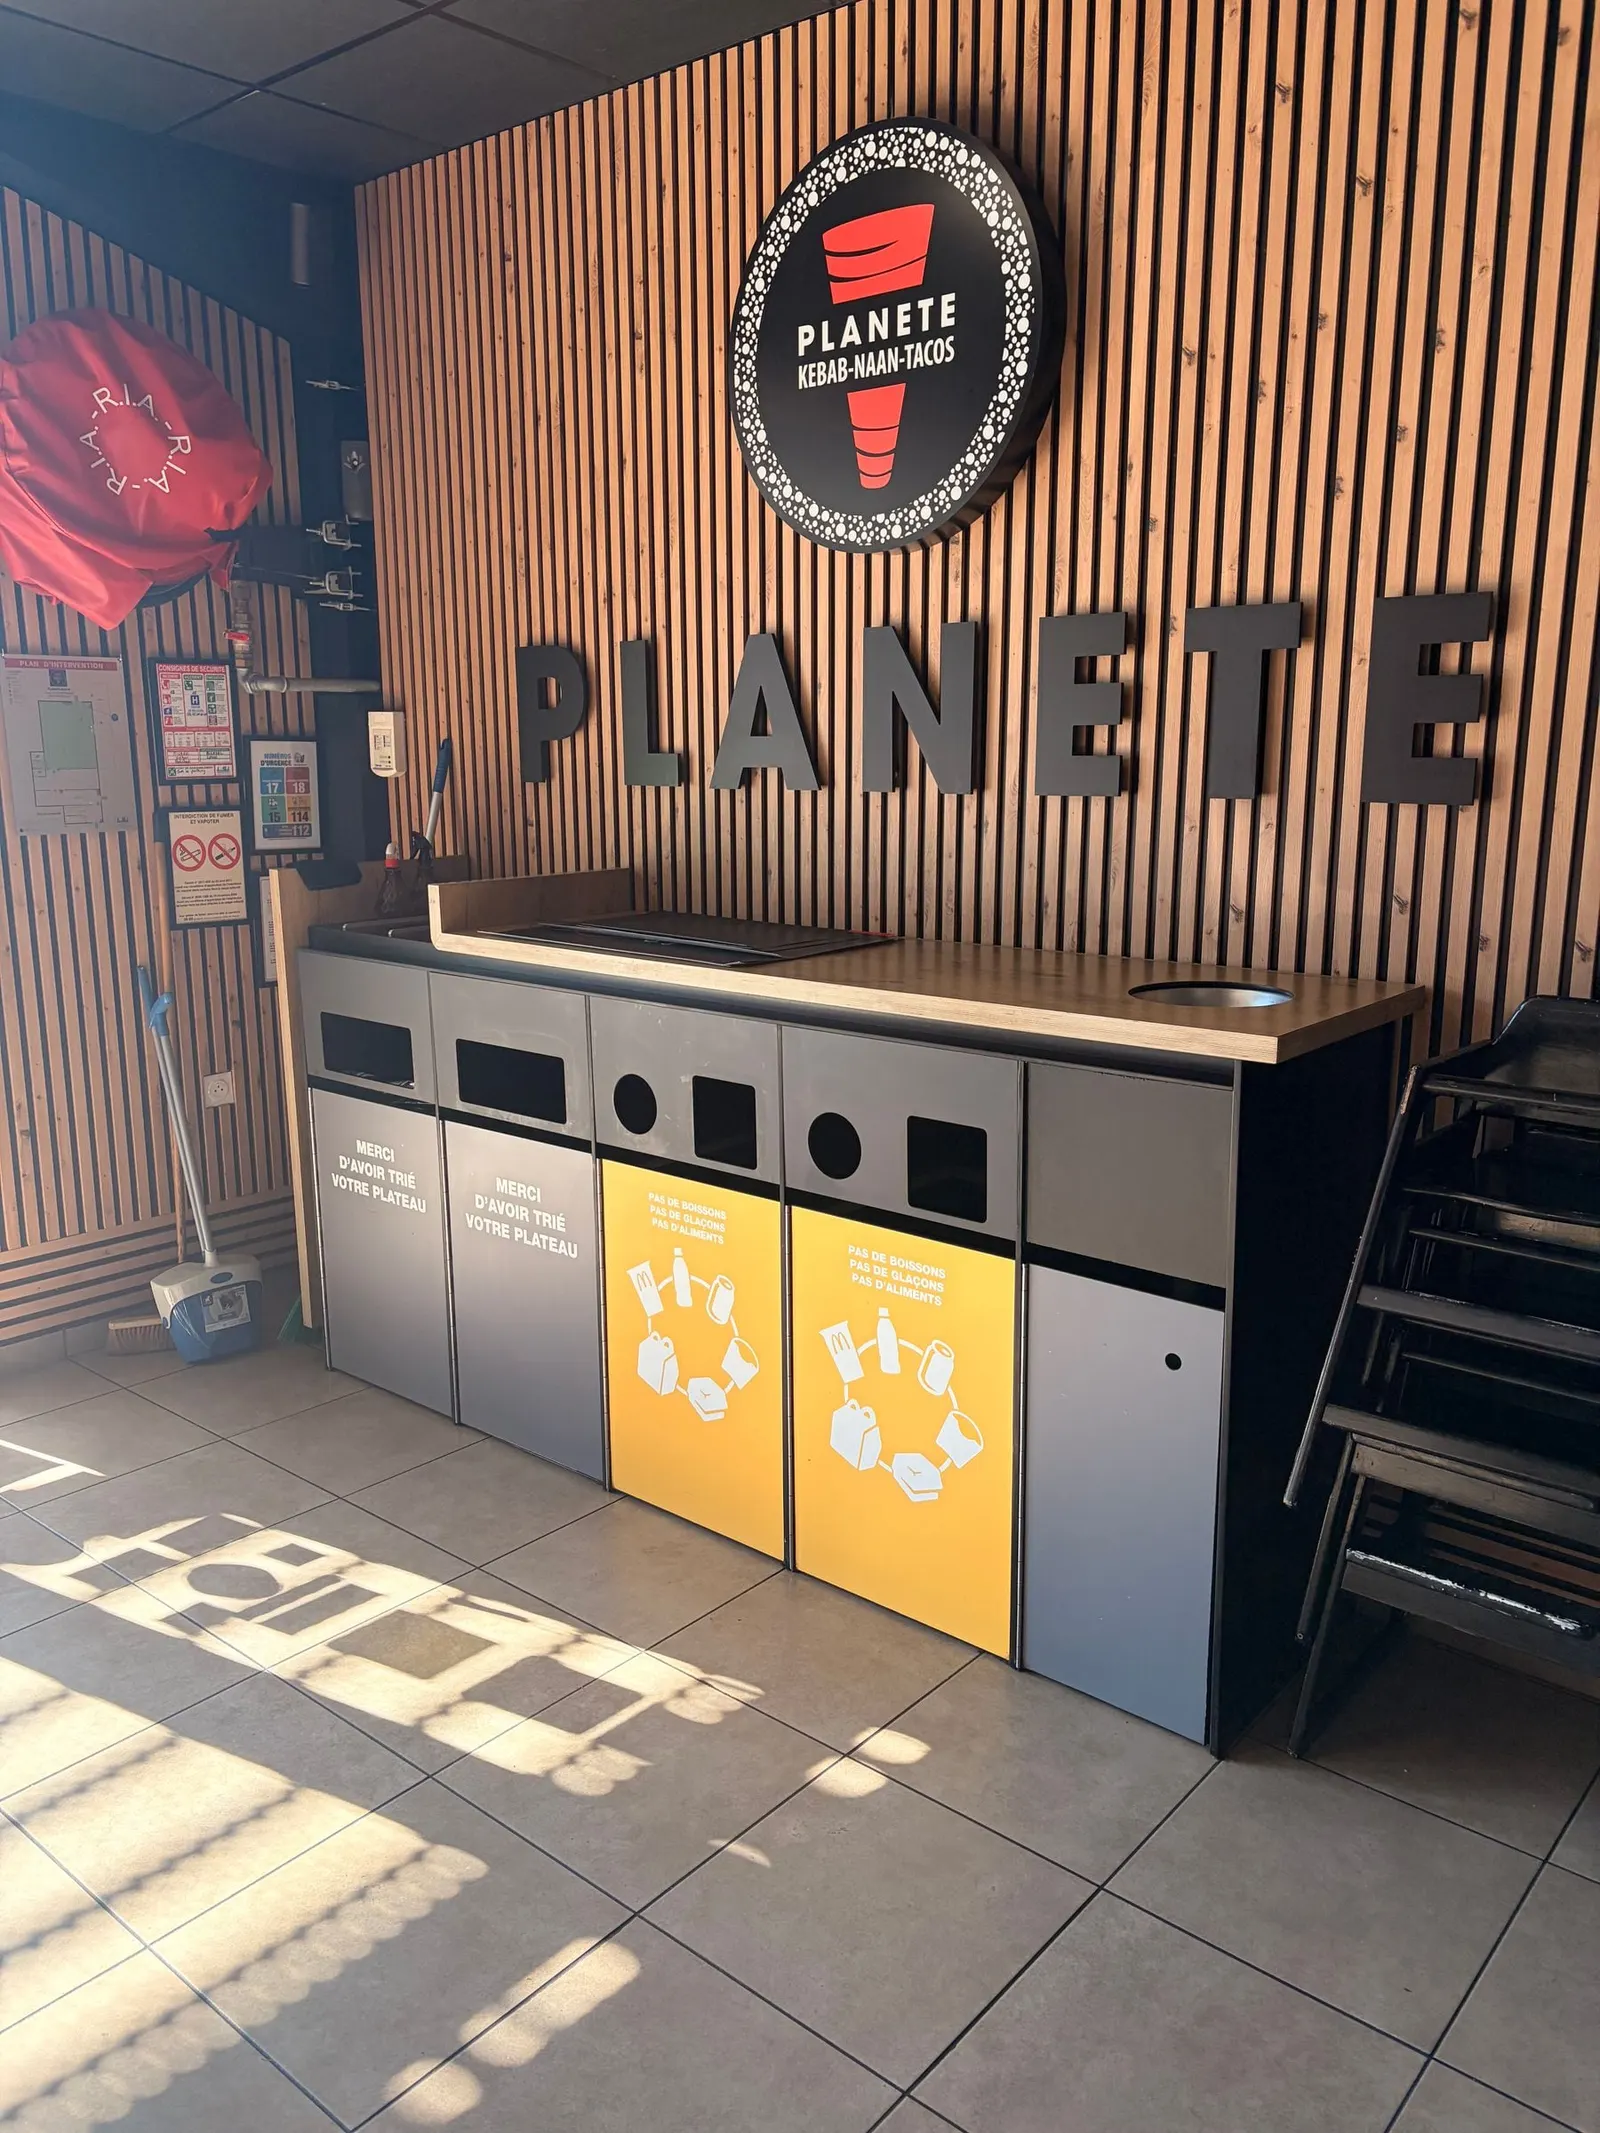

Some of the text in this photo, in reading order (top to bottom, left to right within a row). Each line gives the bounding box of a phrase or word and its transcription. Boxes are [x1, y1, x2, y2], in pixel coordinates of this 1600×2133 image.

[798, 292, 956, 357] PLANETE
[798, 335, 955, 389] KEBAB-NAAN-TACOS
[159, 664, 190, 672] CONSIGNES
[515, 591, 1497, 806] PLANETE
[266, 782, 305, 794] 17 18
[268, 811, 309, 822] 15 114
[292, 825, 310, 836] 112
[356, 1139, 394, 1163] MERCI
[339, 1155, 416, 1190] D'AVOIR TRIÉ
[331, 1172, 426, 1214] VOTRE PLATEAU
[495, 1177, 541, 1203] MERCI
[648, 1192, 727, 1220] PAS DE BOISSONS
[475, 1194, 566, 1233] D'AVOIR TRIÉ
[650, 1205, 725, 1232] PAS DE GLAÇONS
[465, 1212, 578, 1259] VOTRE PLATEAU
[652, 1217, 724, 1244] PAS D'ALIMENTS
[848, 1245, 946, 1279] PAS DE BOISSONS
[850, 1259, 944, 1292] PAS DE GLAÇONS
[852, 1273, 942, 1306] PAS D'ALIMENTS
